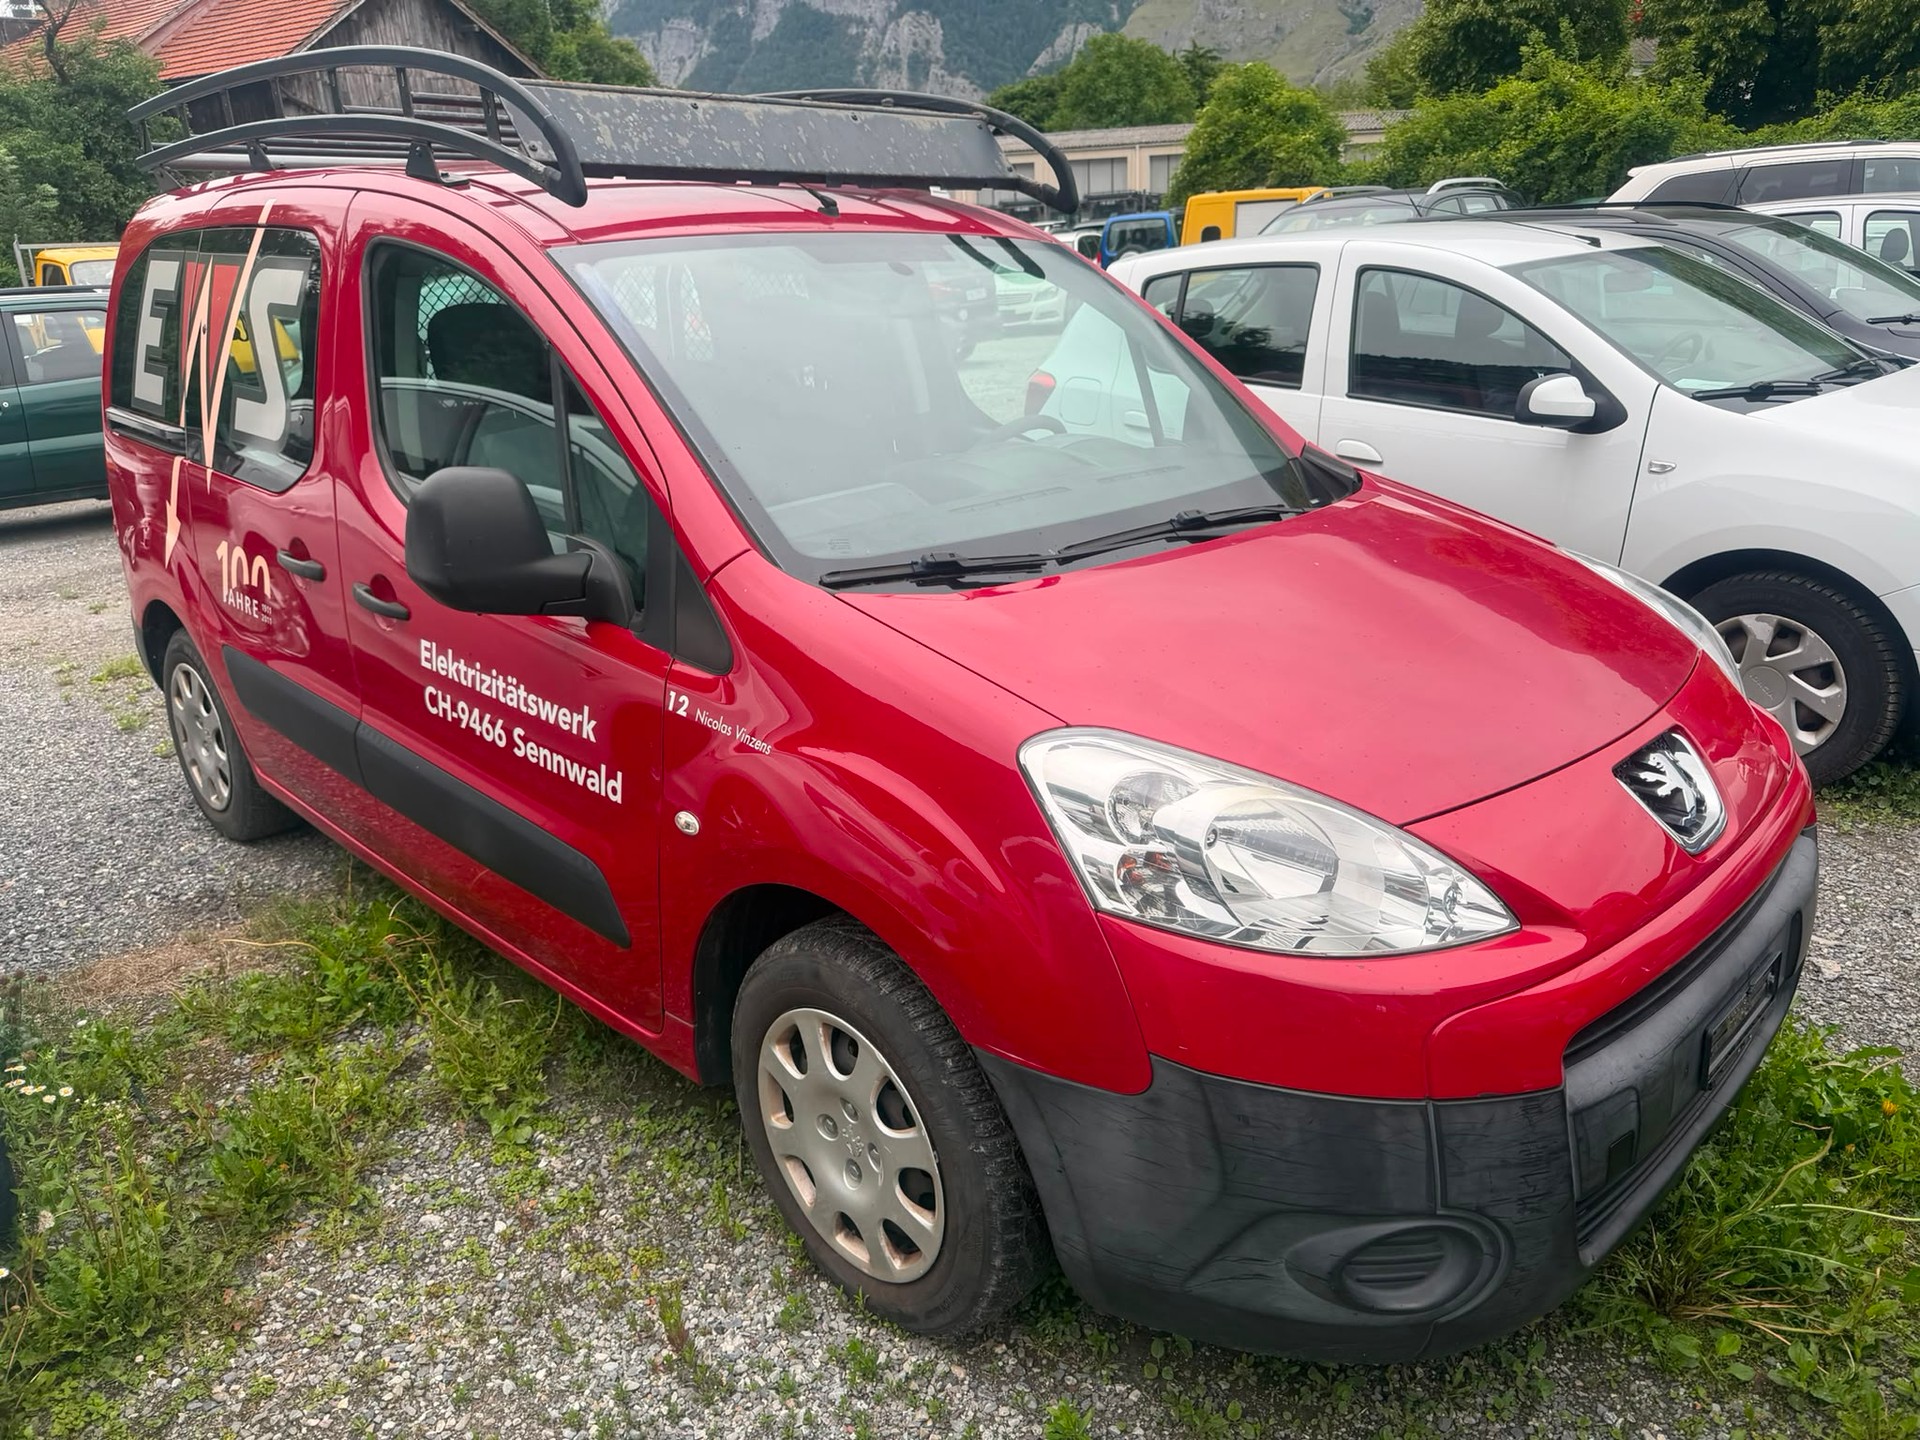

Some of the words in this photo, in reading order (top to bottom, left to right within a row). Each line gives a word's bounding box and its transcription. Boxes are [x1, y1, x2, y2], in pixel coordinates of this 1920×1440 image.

[131, 232, 311, 468] EWS
[216, 540, 271, 602] 100
[419, 638, 598, 743] Elektrizitätswerk
[668, 690, 690, 717] 12
[695, 707, 732, 737] Nicolas
[736, 724, 772, 755] Vinzens
[424, 685, 507, 748] CH-9466
[512, 726, 623, 804] Sennwald
